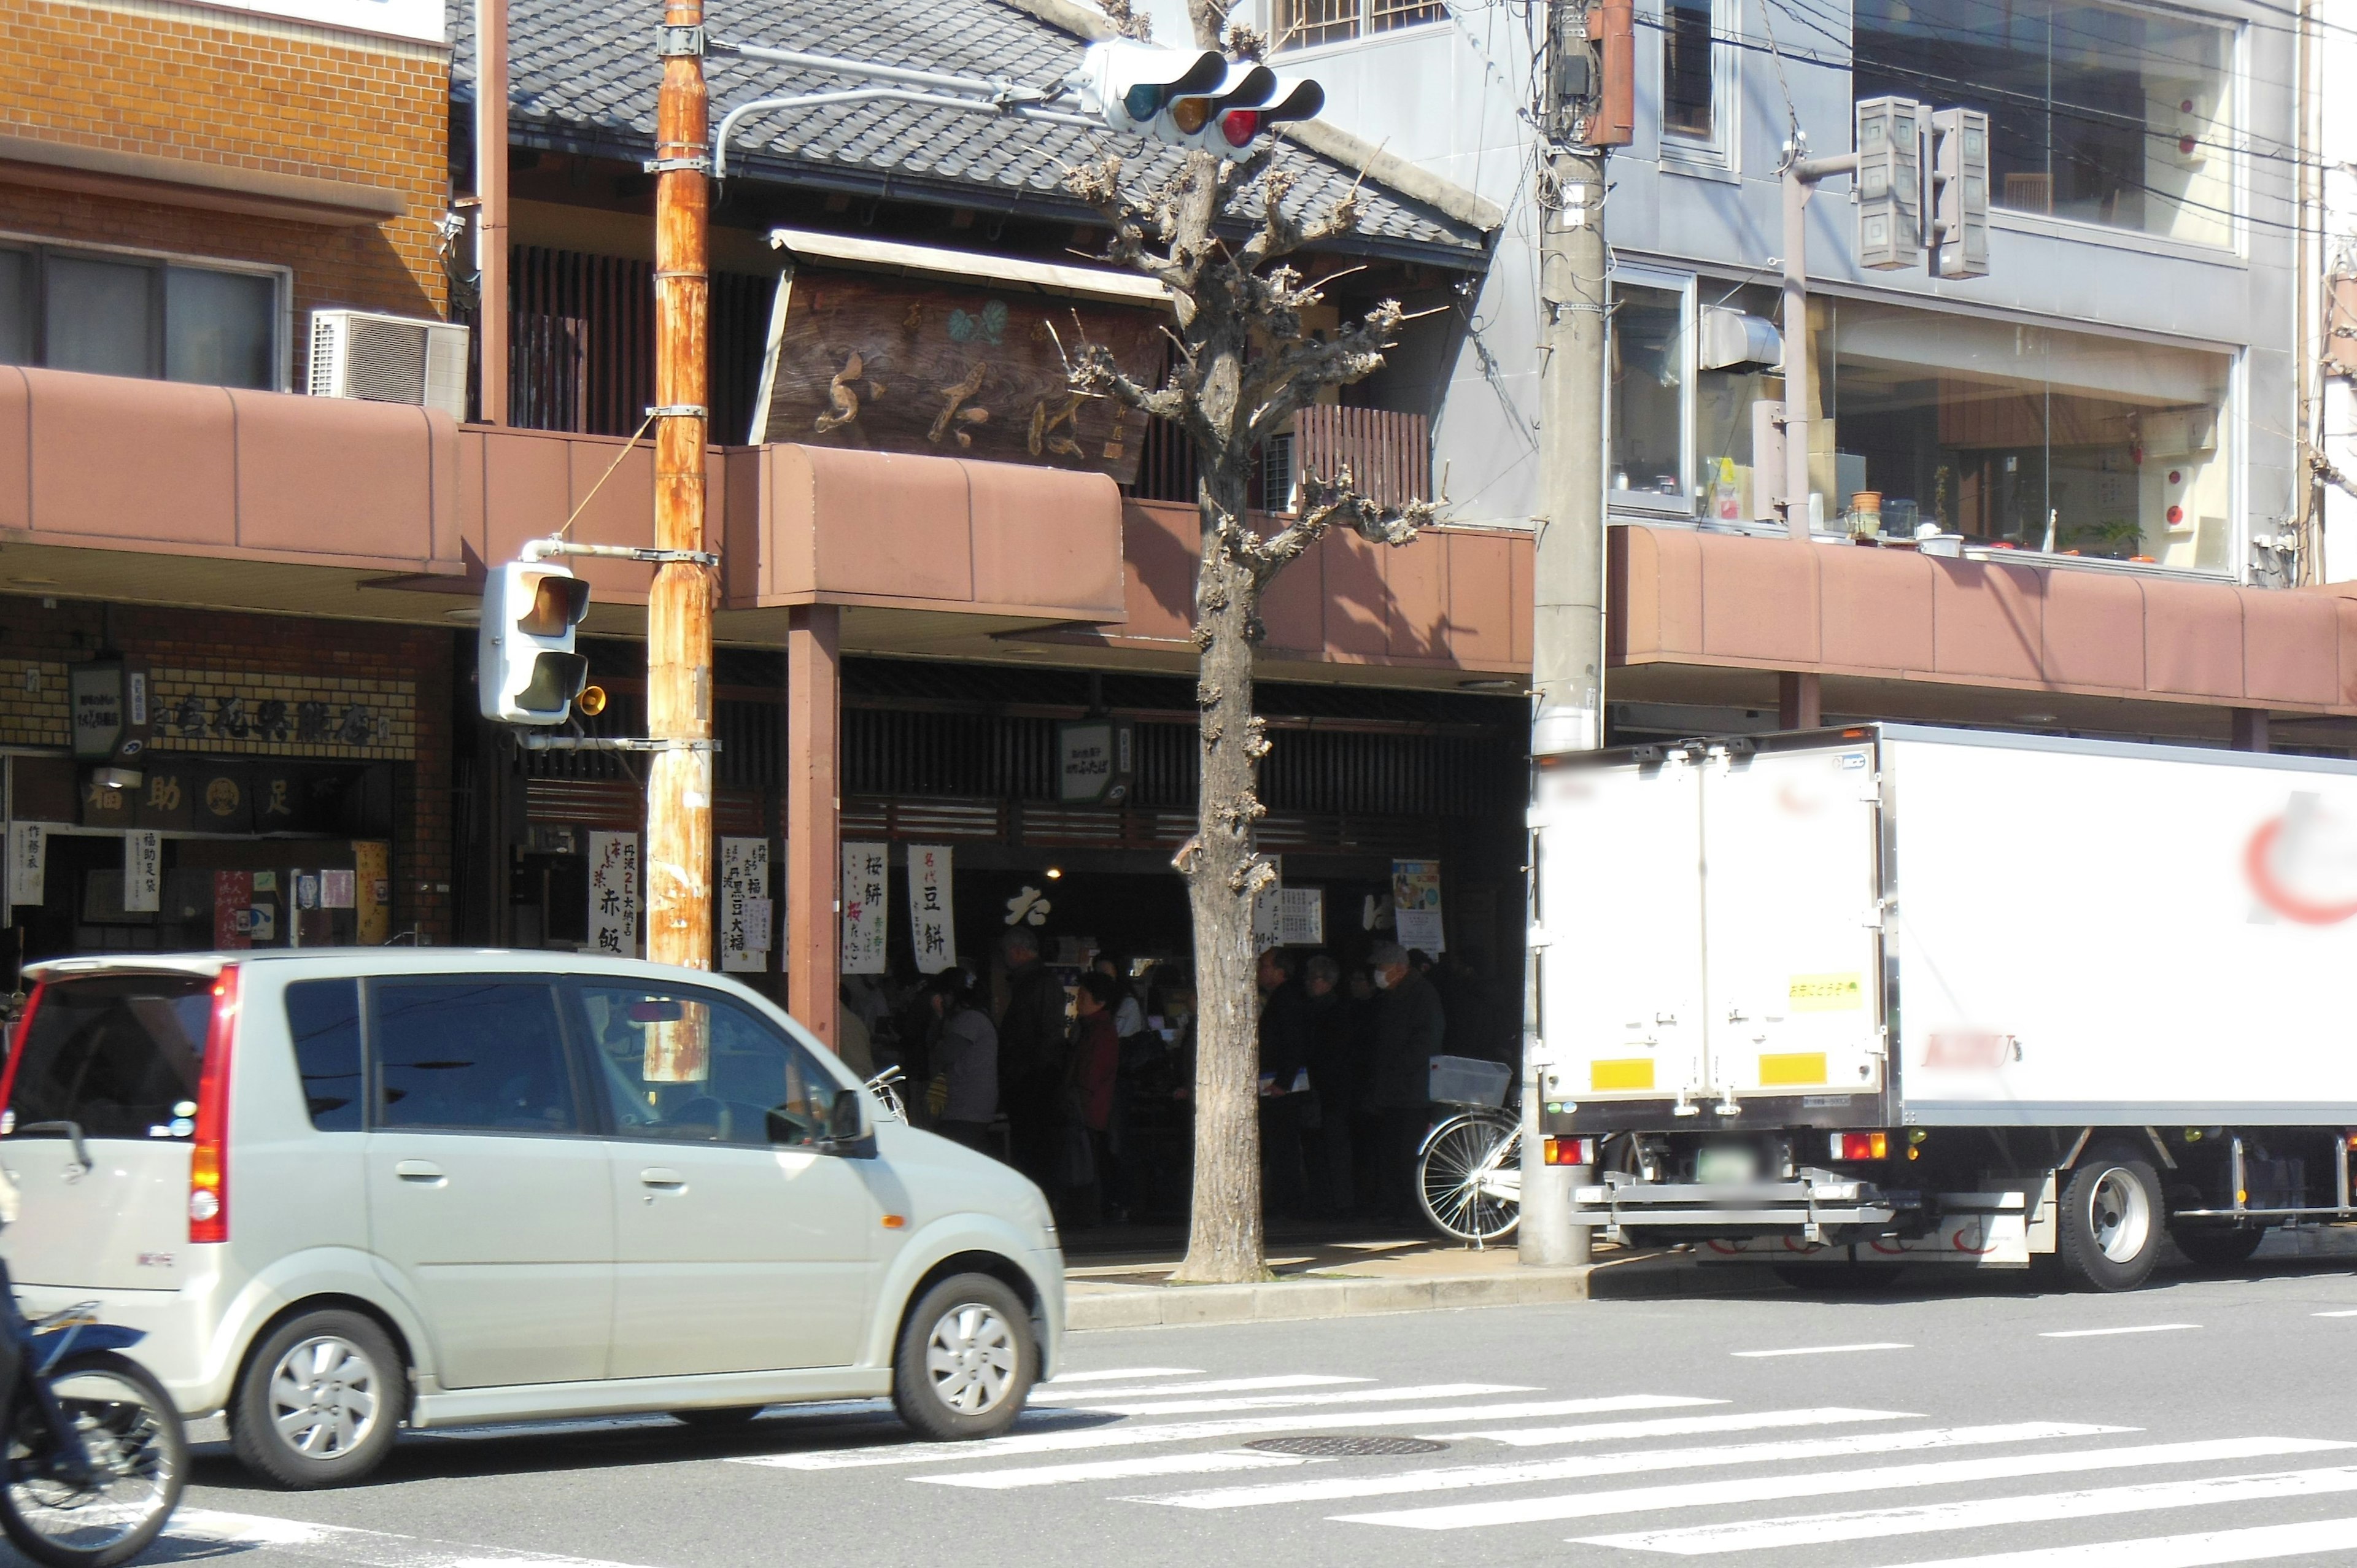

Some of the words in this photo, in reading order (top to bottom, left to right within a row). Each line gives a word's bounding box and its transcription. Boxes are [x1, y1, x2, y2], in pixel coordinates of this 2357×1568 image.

[144, 832, 156, 893] 福助足袋
[865, 853, 883, 906] 桜餅
[598, 888, 622, 954] 赤飯
[730, 880, 745, 951] 黒豆大福
